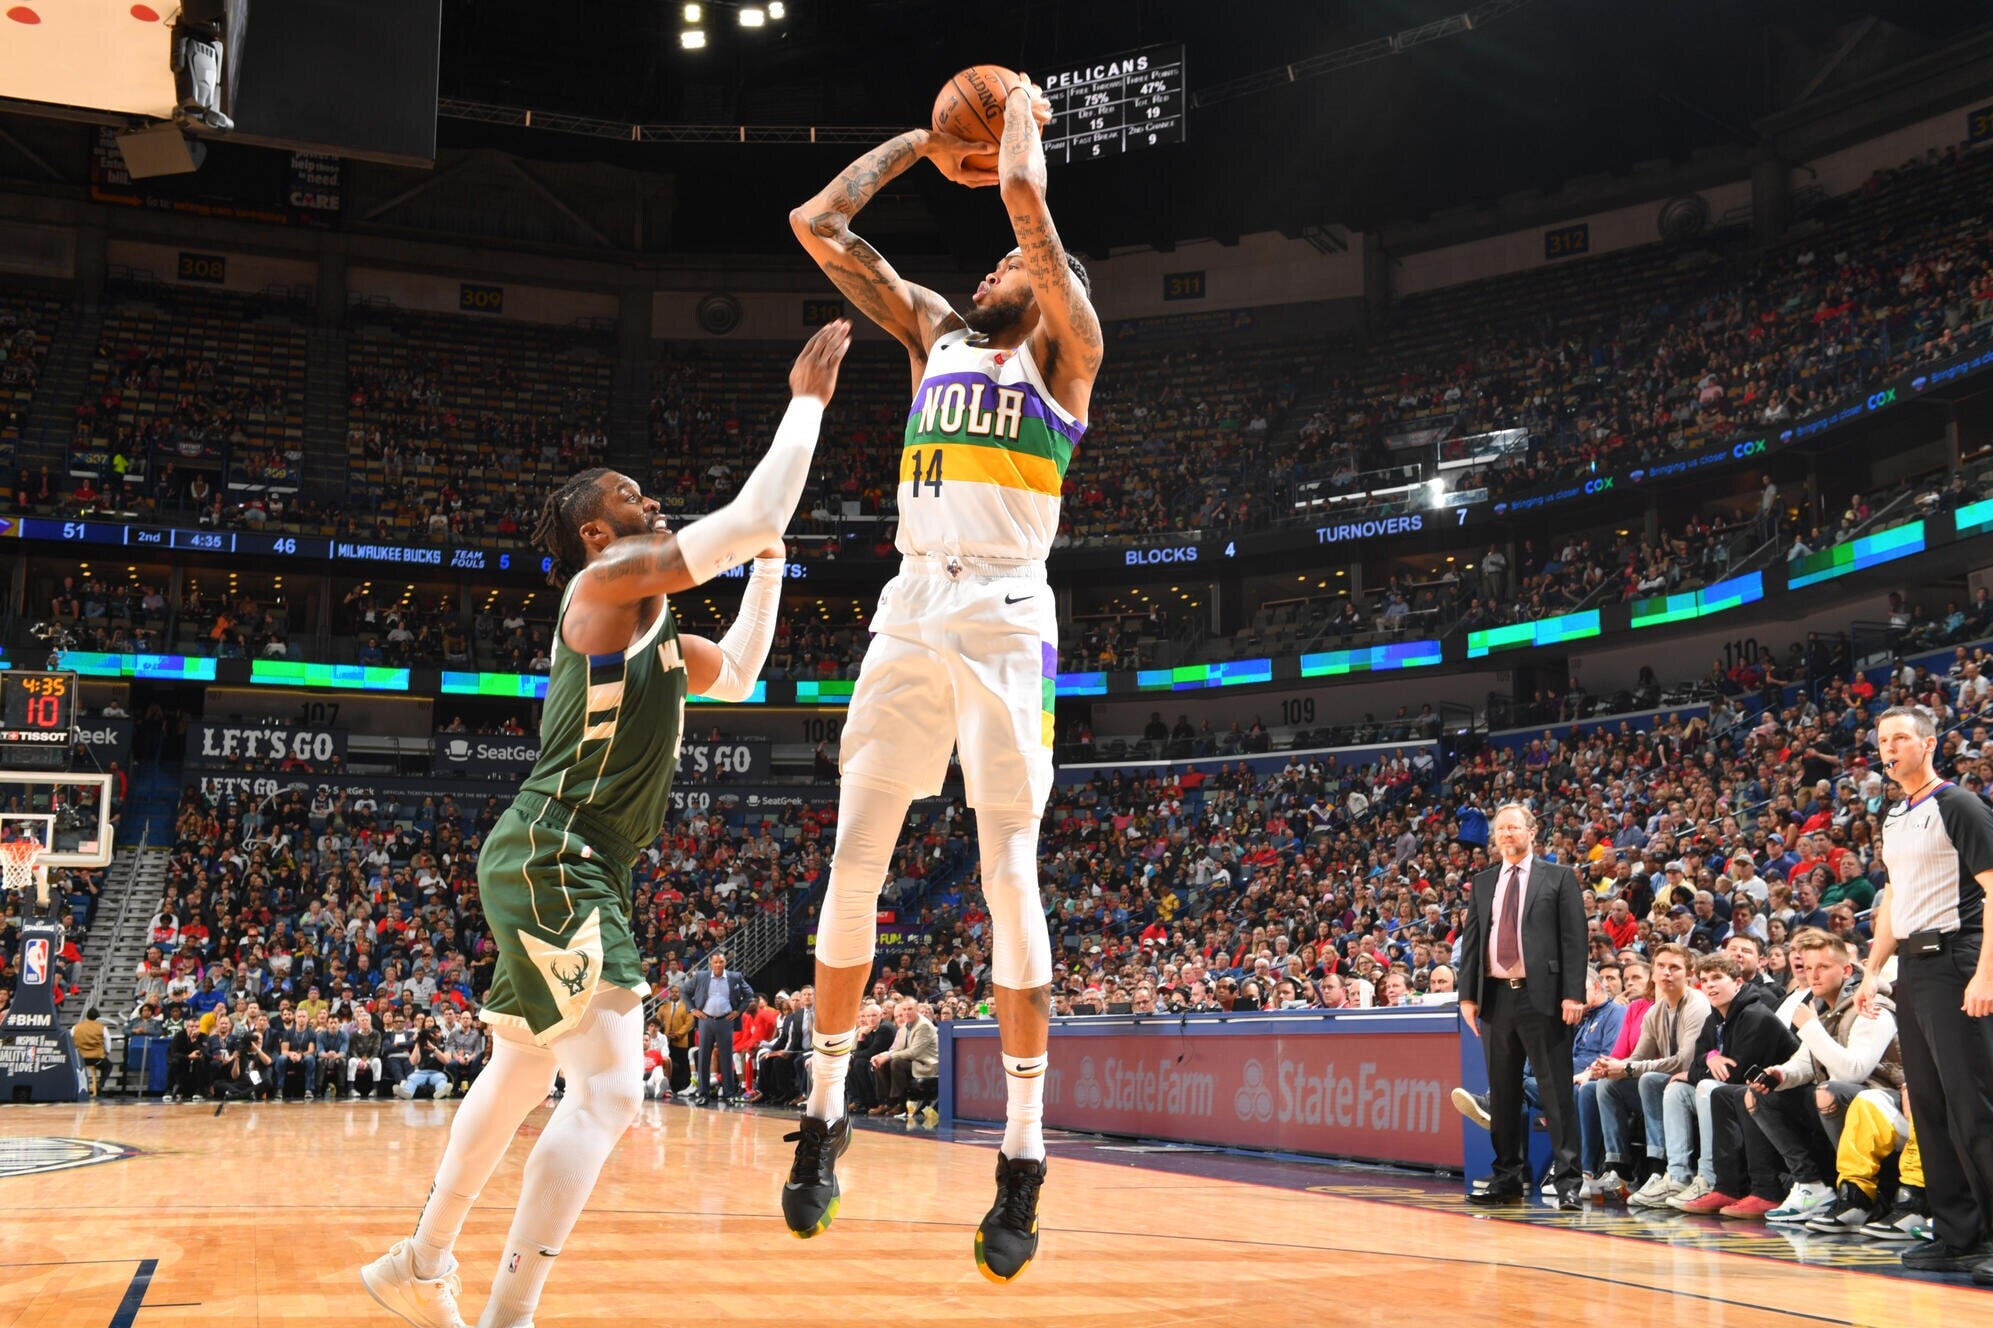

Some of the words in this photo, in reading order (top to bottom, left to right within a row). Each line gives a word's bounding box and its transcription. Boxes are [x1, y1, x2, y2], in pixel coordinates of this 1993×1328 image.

[1046, 56, 1148, 89] PELICANS
[1140, 80, 1166, 94] 47%
[1084, 92, 1109, 106] 75%
[1146, 107, 1160, 119] 19
[1090, 118, 1104, 130] 15
[1148, 133, 1157, 145] 9
[1092, 144, 1101, 156] 5
[289, 191, 340, 211] CARE
[1549, 228, 1586, 253] 312
[182, 259, 224, 278] 308
[1170, 276, 1200, 294] 311
[463, 289, 502, 309] 309
[1867, 387, 1896, 411] COX
[917, 383, 1024, 443] NOLA
[1733, 438, 1766, 459] COX
[912, 449, 943, 498] 14
[1584, 476, 1614, 494] COX
[1316, 515, 1422, 543] TURNOVERS
[1456, 508, 1468, 526] 7
[62, 522, 87, 540] 51
[138, 530, 161, 544] 2nd
[190, 534, 223, 549] 4:35
[273, 537, 297, 555] 46
[338, 544, 402, 562] MILWAUKEE
[403, 549, 441, 564] BUCKS
[451, 558, 485, 569] FOULS
[499, 554, 510, 569] 5
[453, 549, 483, 560] TEAM
[1125, 546, 1198, 566] BLOCKS
[1225, 542, 1235, 557] 4
[22, 678, 65, 696] 4:35
[27, 696, 59, 727] 10
[302, 701, 340, 726] 107
[1281, 698, 1315, 725] 109
[20, 731, 67, 741] TISSOT
[802, 719, 838, 744] 108
[202, 728, 287, 759] LET'S
[292, 731, 334, 761] GO
[477, 744, 541, 761] SeatGee
[714, 745, 752, 773] GO
[7, 1014, 52, 1026] #BHM
[14, 1063, 34, 1073] LOVE
